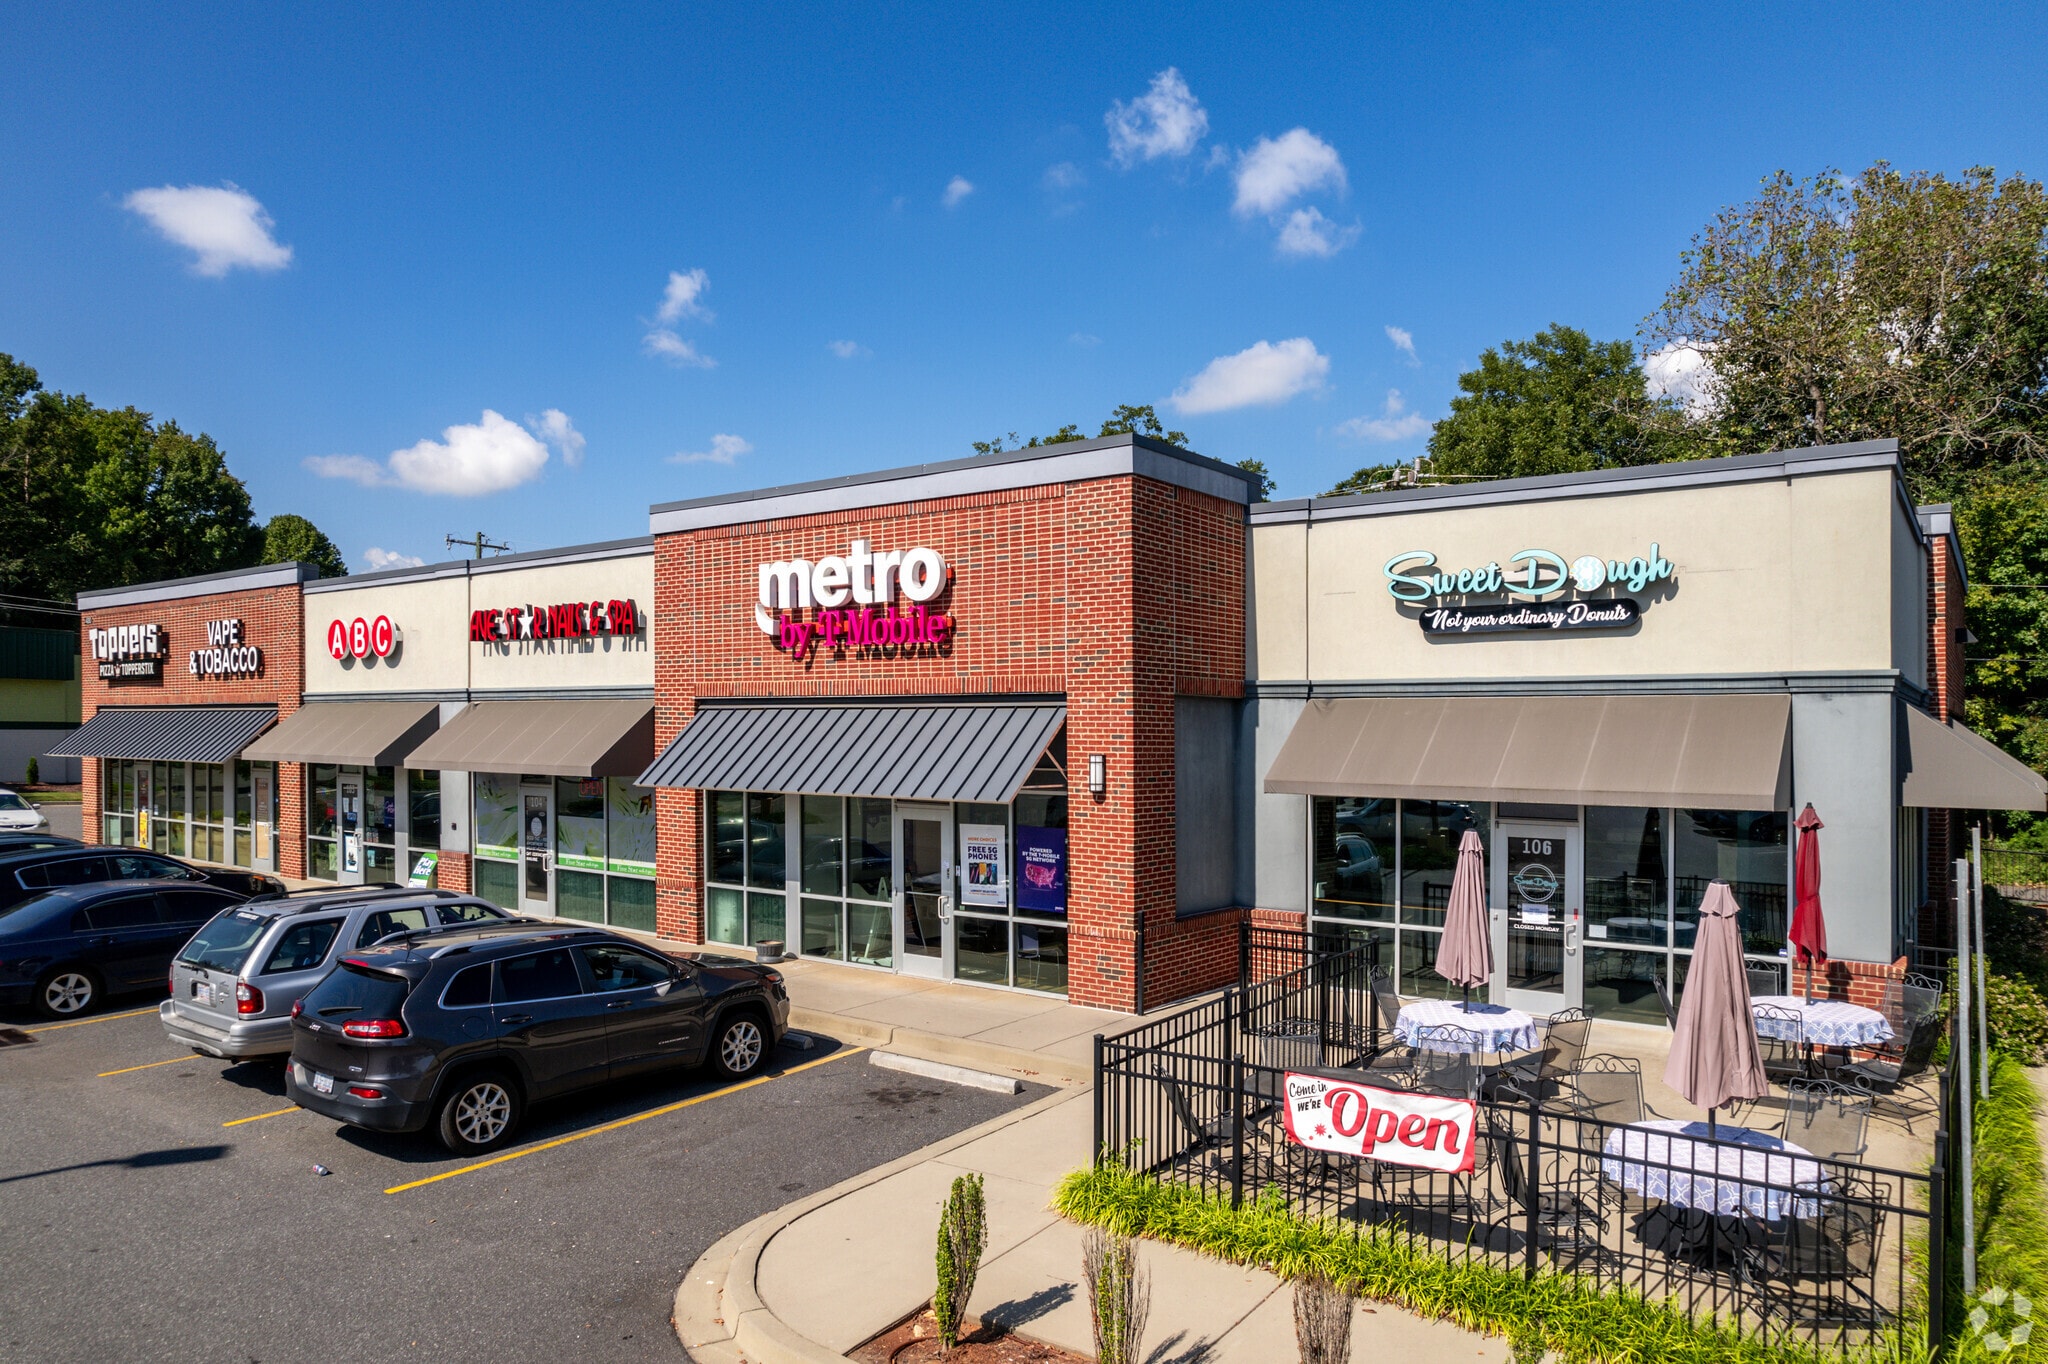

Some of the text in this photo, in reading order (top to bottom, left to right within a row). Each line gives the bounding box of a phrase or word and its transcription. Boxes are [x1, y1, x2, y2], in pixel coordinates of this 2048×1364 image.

[757, 539, 946, 608] metro
[1383, 550, 1502, 600] Sweet
[548, 602, 584, 639] NAILS
[589, 601, 600, 637] &
[607, 599, 634, 635] SPA
[1424, 602, 1632, 632] Not your ordinary Donuts
[89, 624, 158, 660] Toppers
[206, 619, 239, 646] VAPE
[331, 616, 392, 656] ABC
[780, 615, 814, 658] by
[99, 662, 155, 677] PIZZA TOPPERSTIX
[189, 646, 258, 674] & TOBACCO
[580, 778, 603, 795] OPEN
[531, 796, 543, 808] 104
[968, 845, 998, 854] FREE 5G
[1522, 839, 1553, 856] 106
[1535, 924, 1560, 933] MONDAY
[1288, 1080, 1329, 1098] Come in
[1297, 1098, 1322, 1112] WE'RE
[1324, 1086, 1461, 1155] Open
